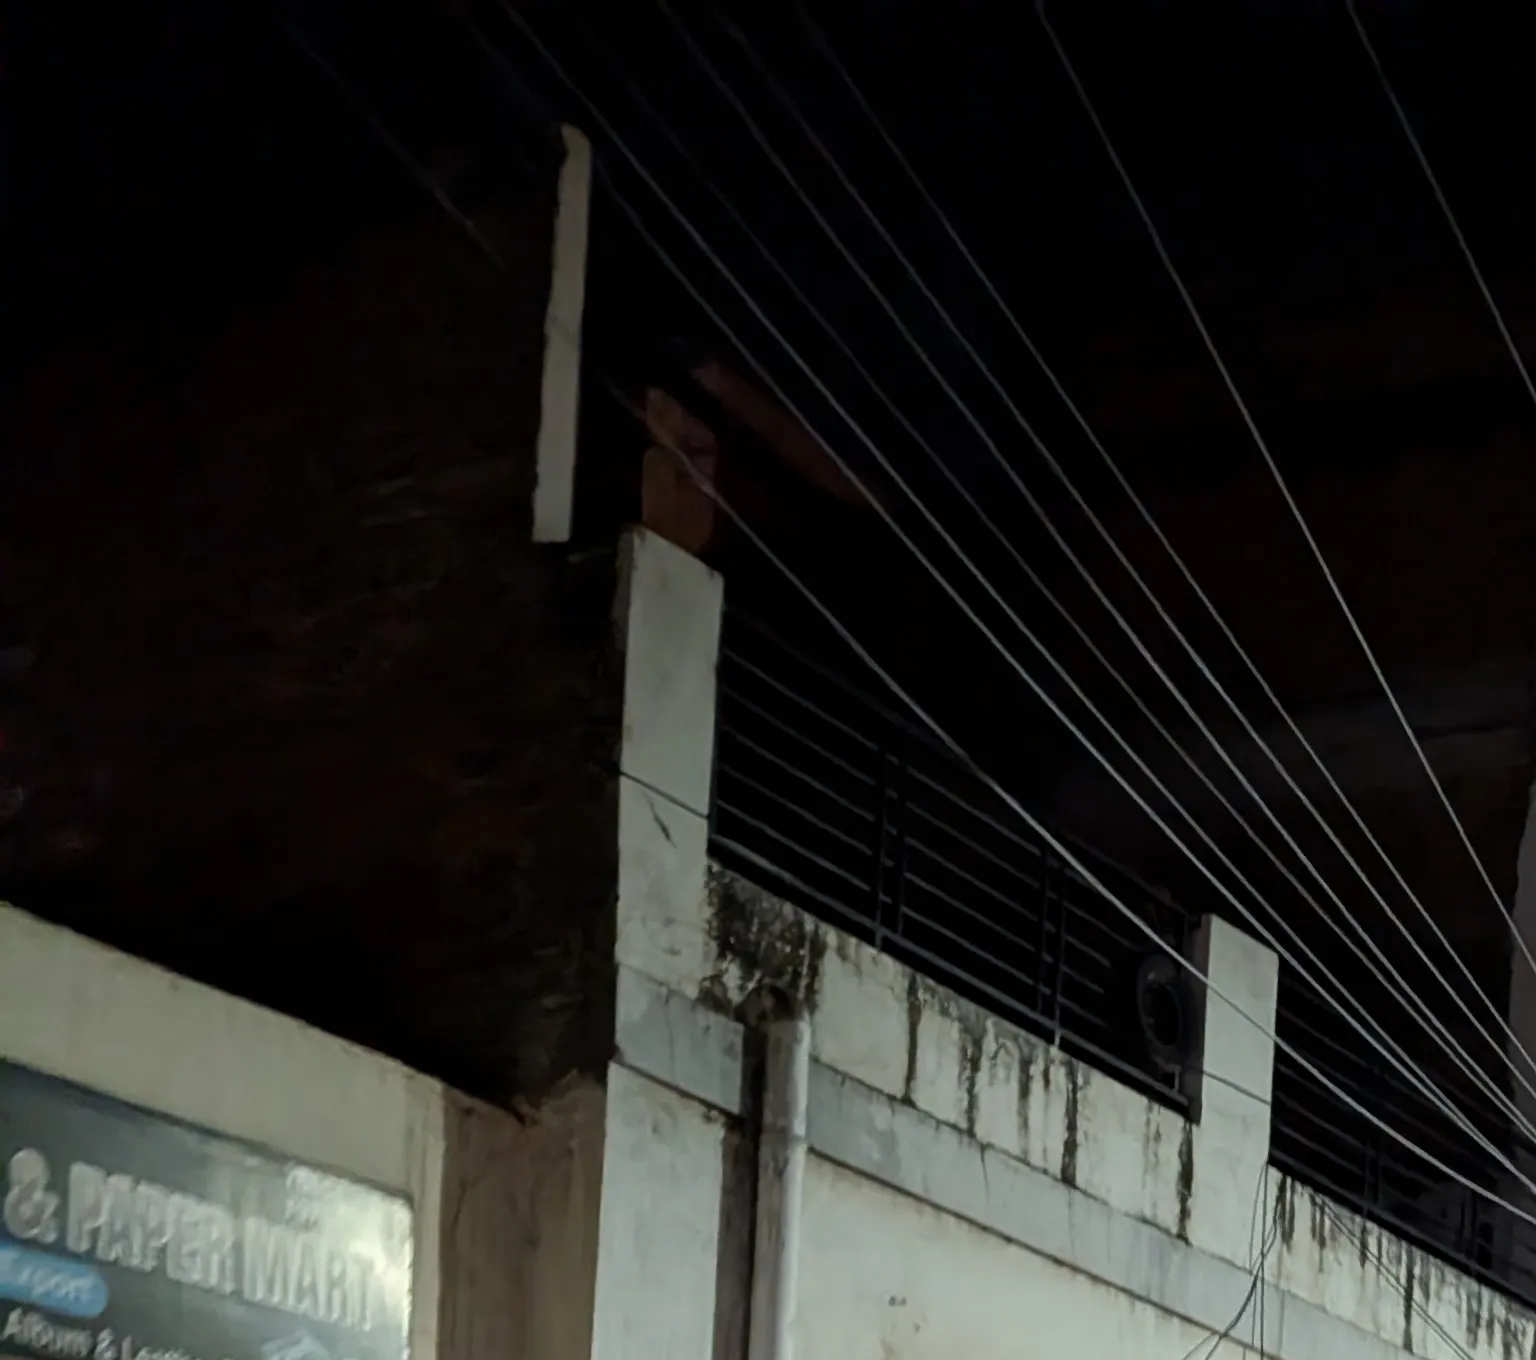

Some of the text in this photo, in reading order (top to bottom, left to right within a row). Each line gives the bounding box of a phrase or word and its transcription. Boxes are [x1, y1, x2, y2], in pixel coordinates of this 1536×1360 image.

[4, 1148, 373, 1332] & PAPER MART
